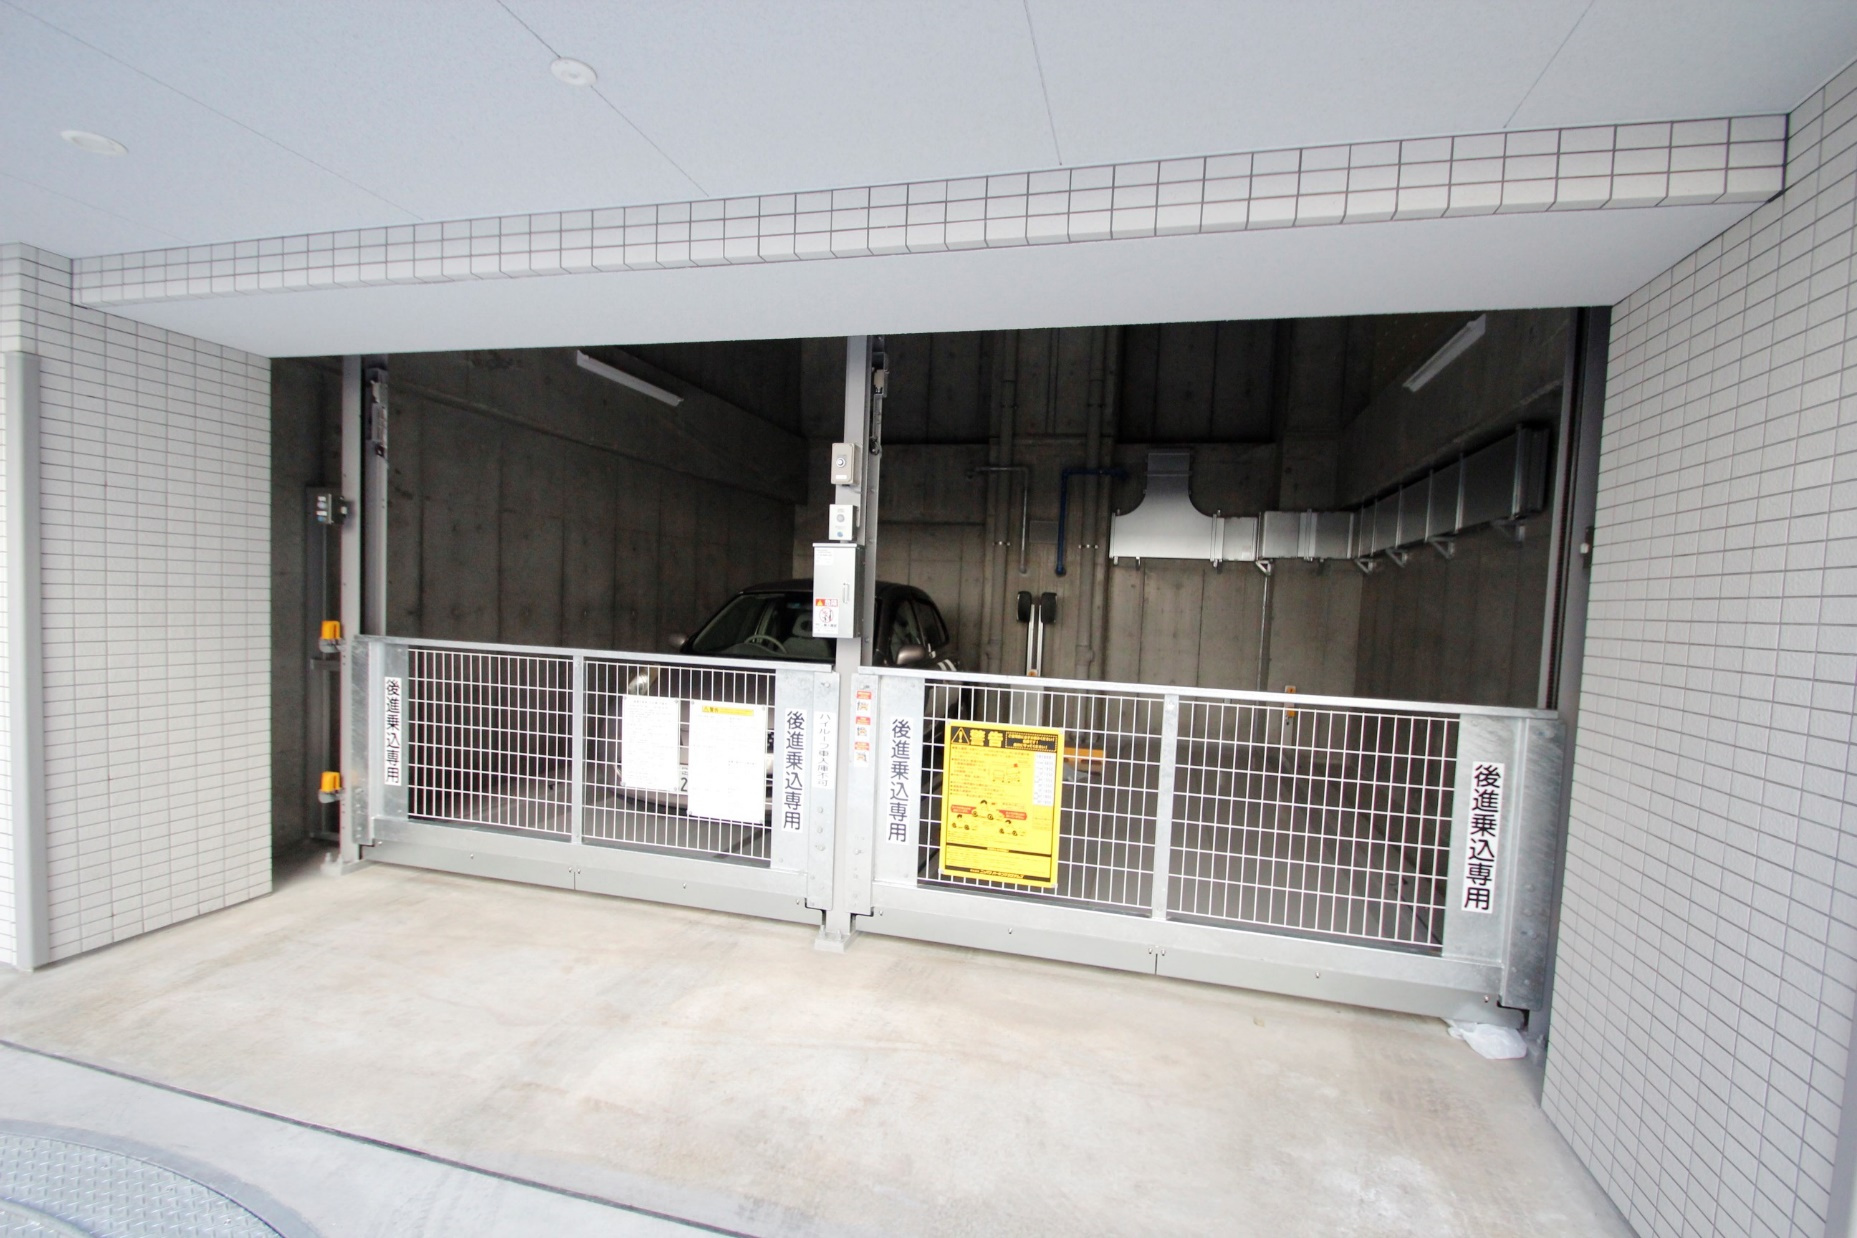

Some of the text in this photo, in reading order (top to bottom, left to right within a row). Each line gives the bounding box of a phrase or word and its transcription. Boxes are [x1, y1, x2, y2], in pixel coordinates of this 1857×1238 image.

[385, 679, 401, 784] 後進乗込専用
[783, 710, 806, 831] 後進乗込専用
[817, 713, 831, 787] ハイルーフ車入庫不可
[888, 718, 912, 843] 後進乗込専用
[969, 728, 1004, 748] 警告
[1464, 764, 1502, 911] 後進乗込専用
